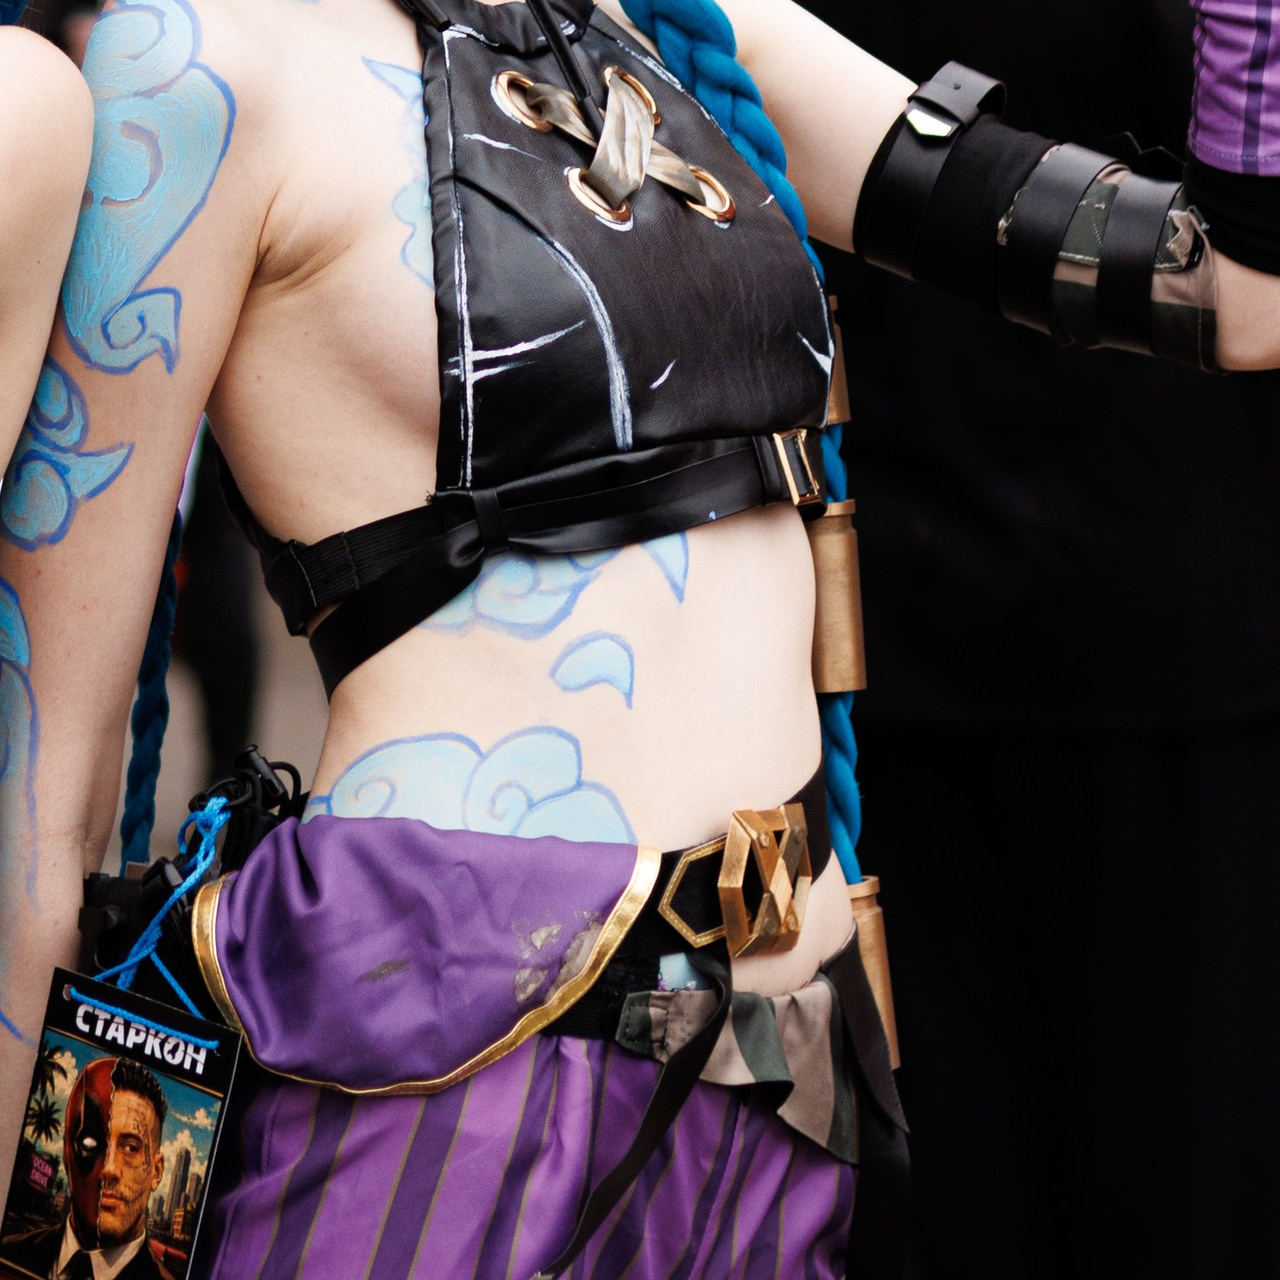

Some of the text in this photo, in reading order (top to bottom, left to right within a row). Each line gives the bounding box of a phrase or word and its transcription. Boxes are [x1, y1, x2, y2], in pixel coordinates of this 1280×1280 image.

[75, 1003, 207, 1075] СТАРКОН
[33, 1156, 53, 1177] OCEAN
[30, 1168, 49, 1187] DRIVE
